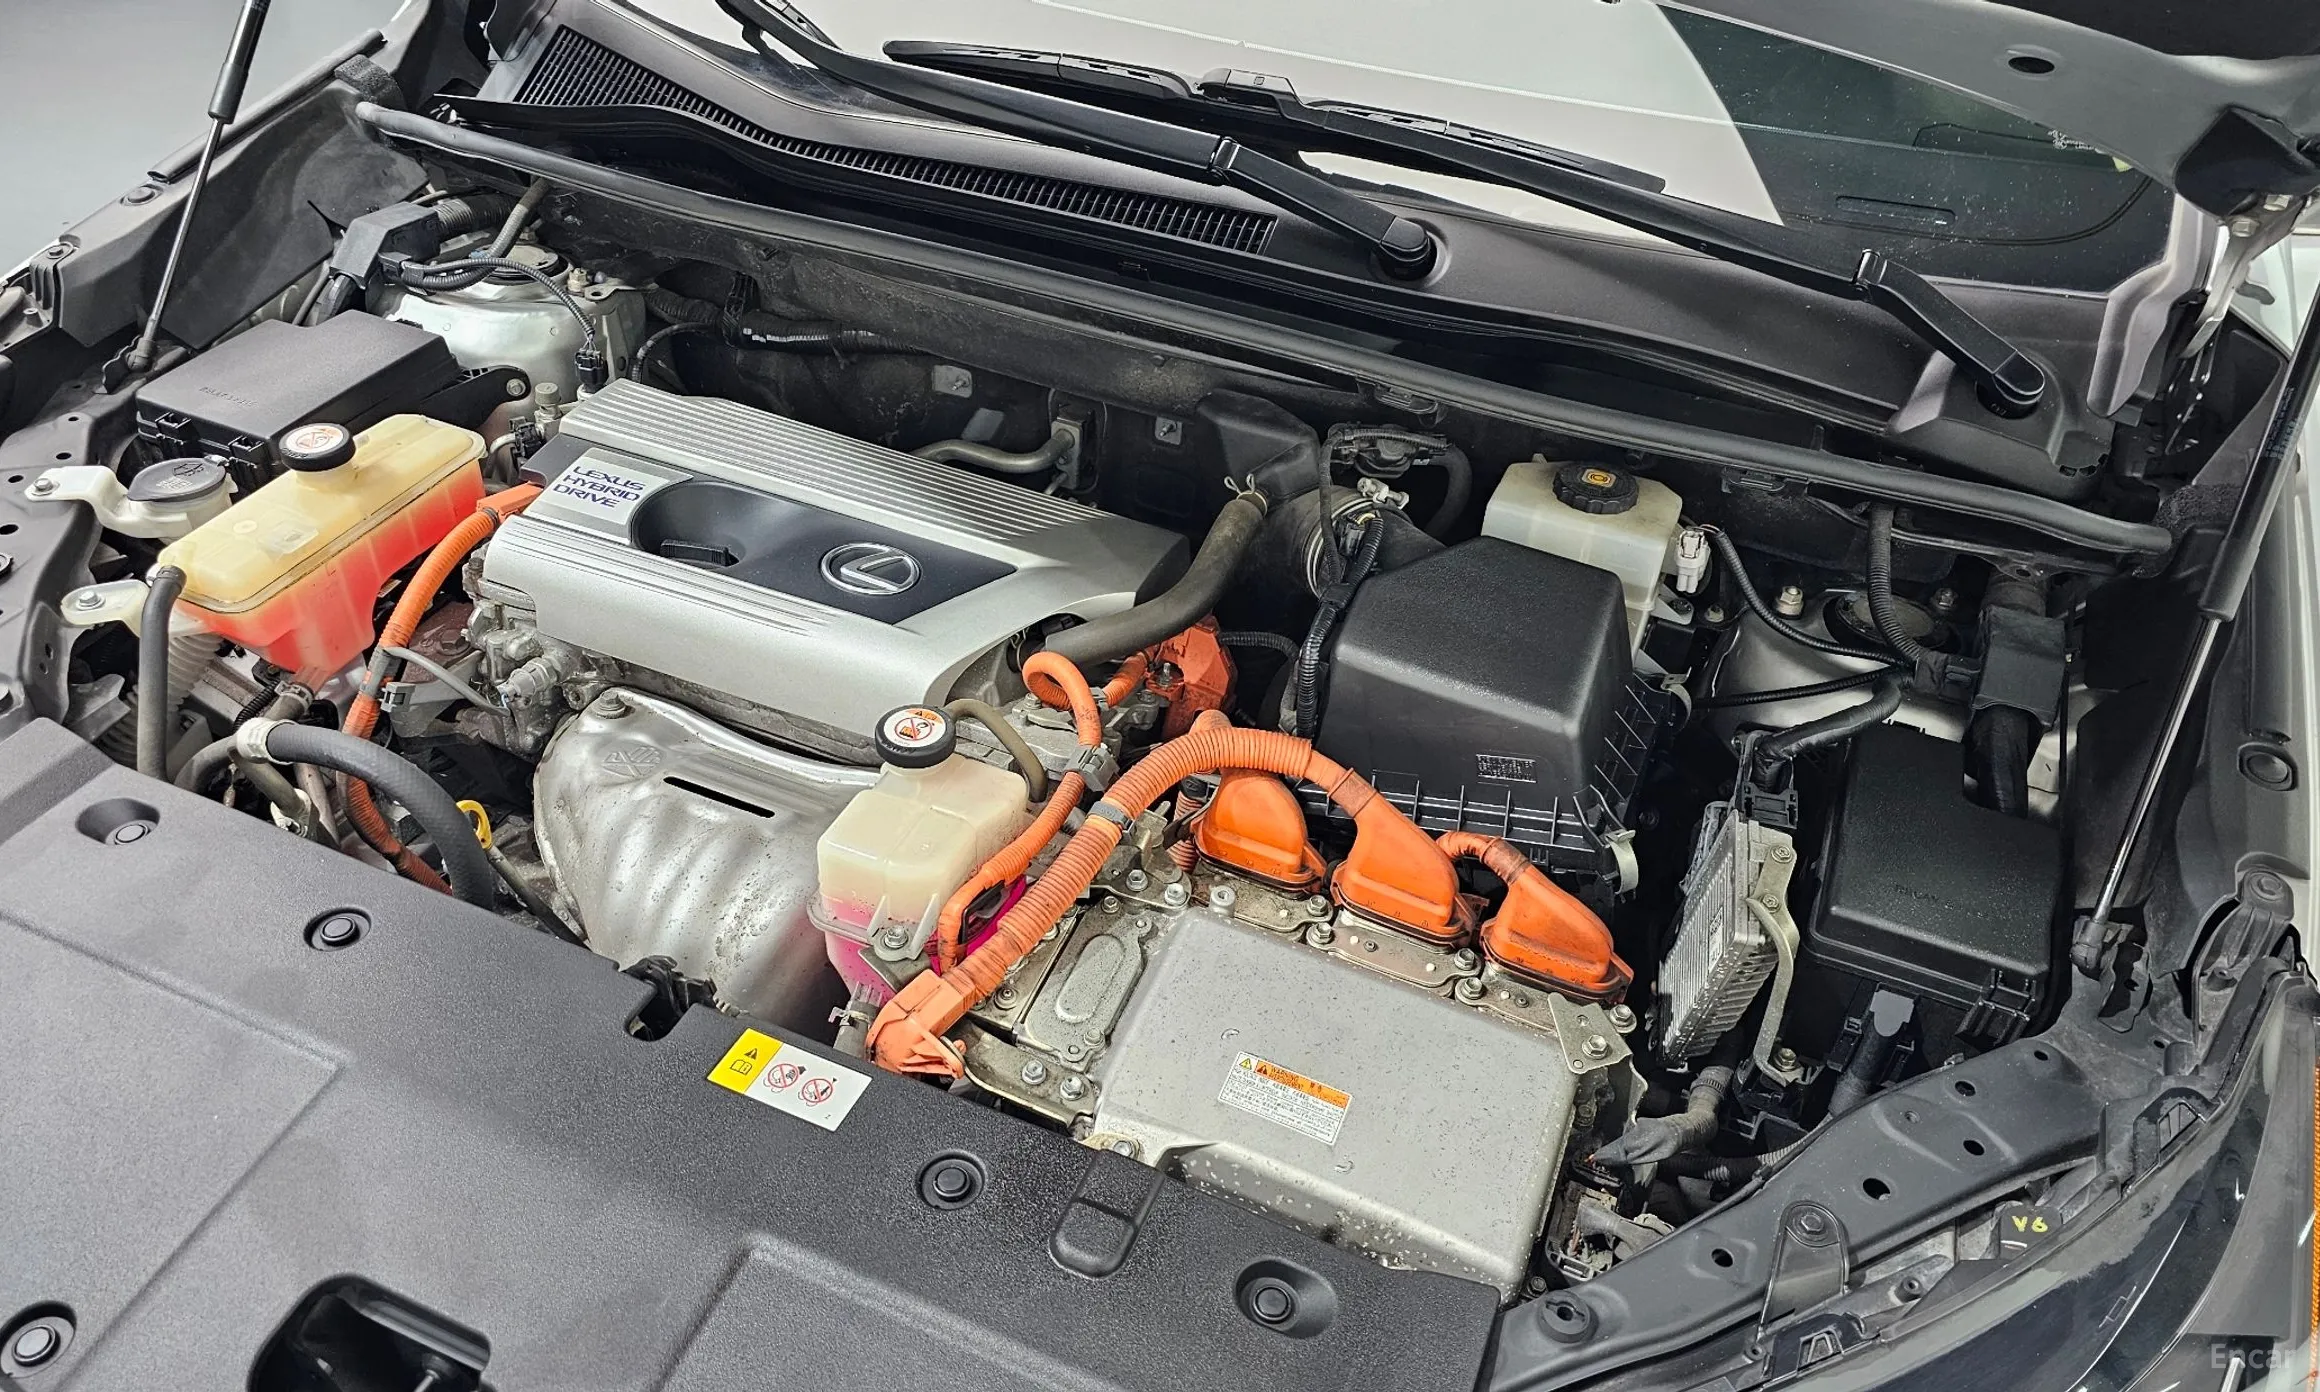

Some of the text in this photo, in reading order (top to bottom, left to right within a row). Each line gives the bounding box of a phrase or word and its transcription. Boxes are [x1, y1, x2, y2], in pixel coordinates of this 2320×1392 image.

[562, 475, 641, 501] HYBRID
[573, 466, 646, 491] LEXUS
[553, 484, 620, 508] DRIVE
[2011, 1215, 2048, 1233] V6
